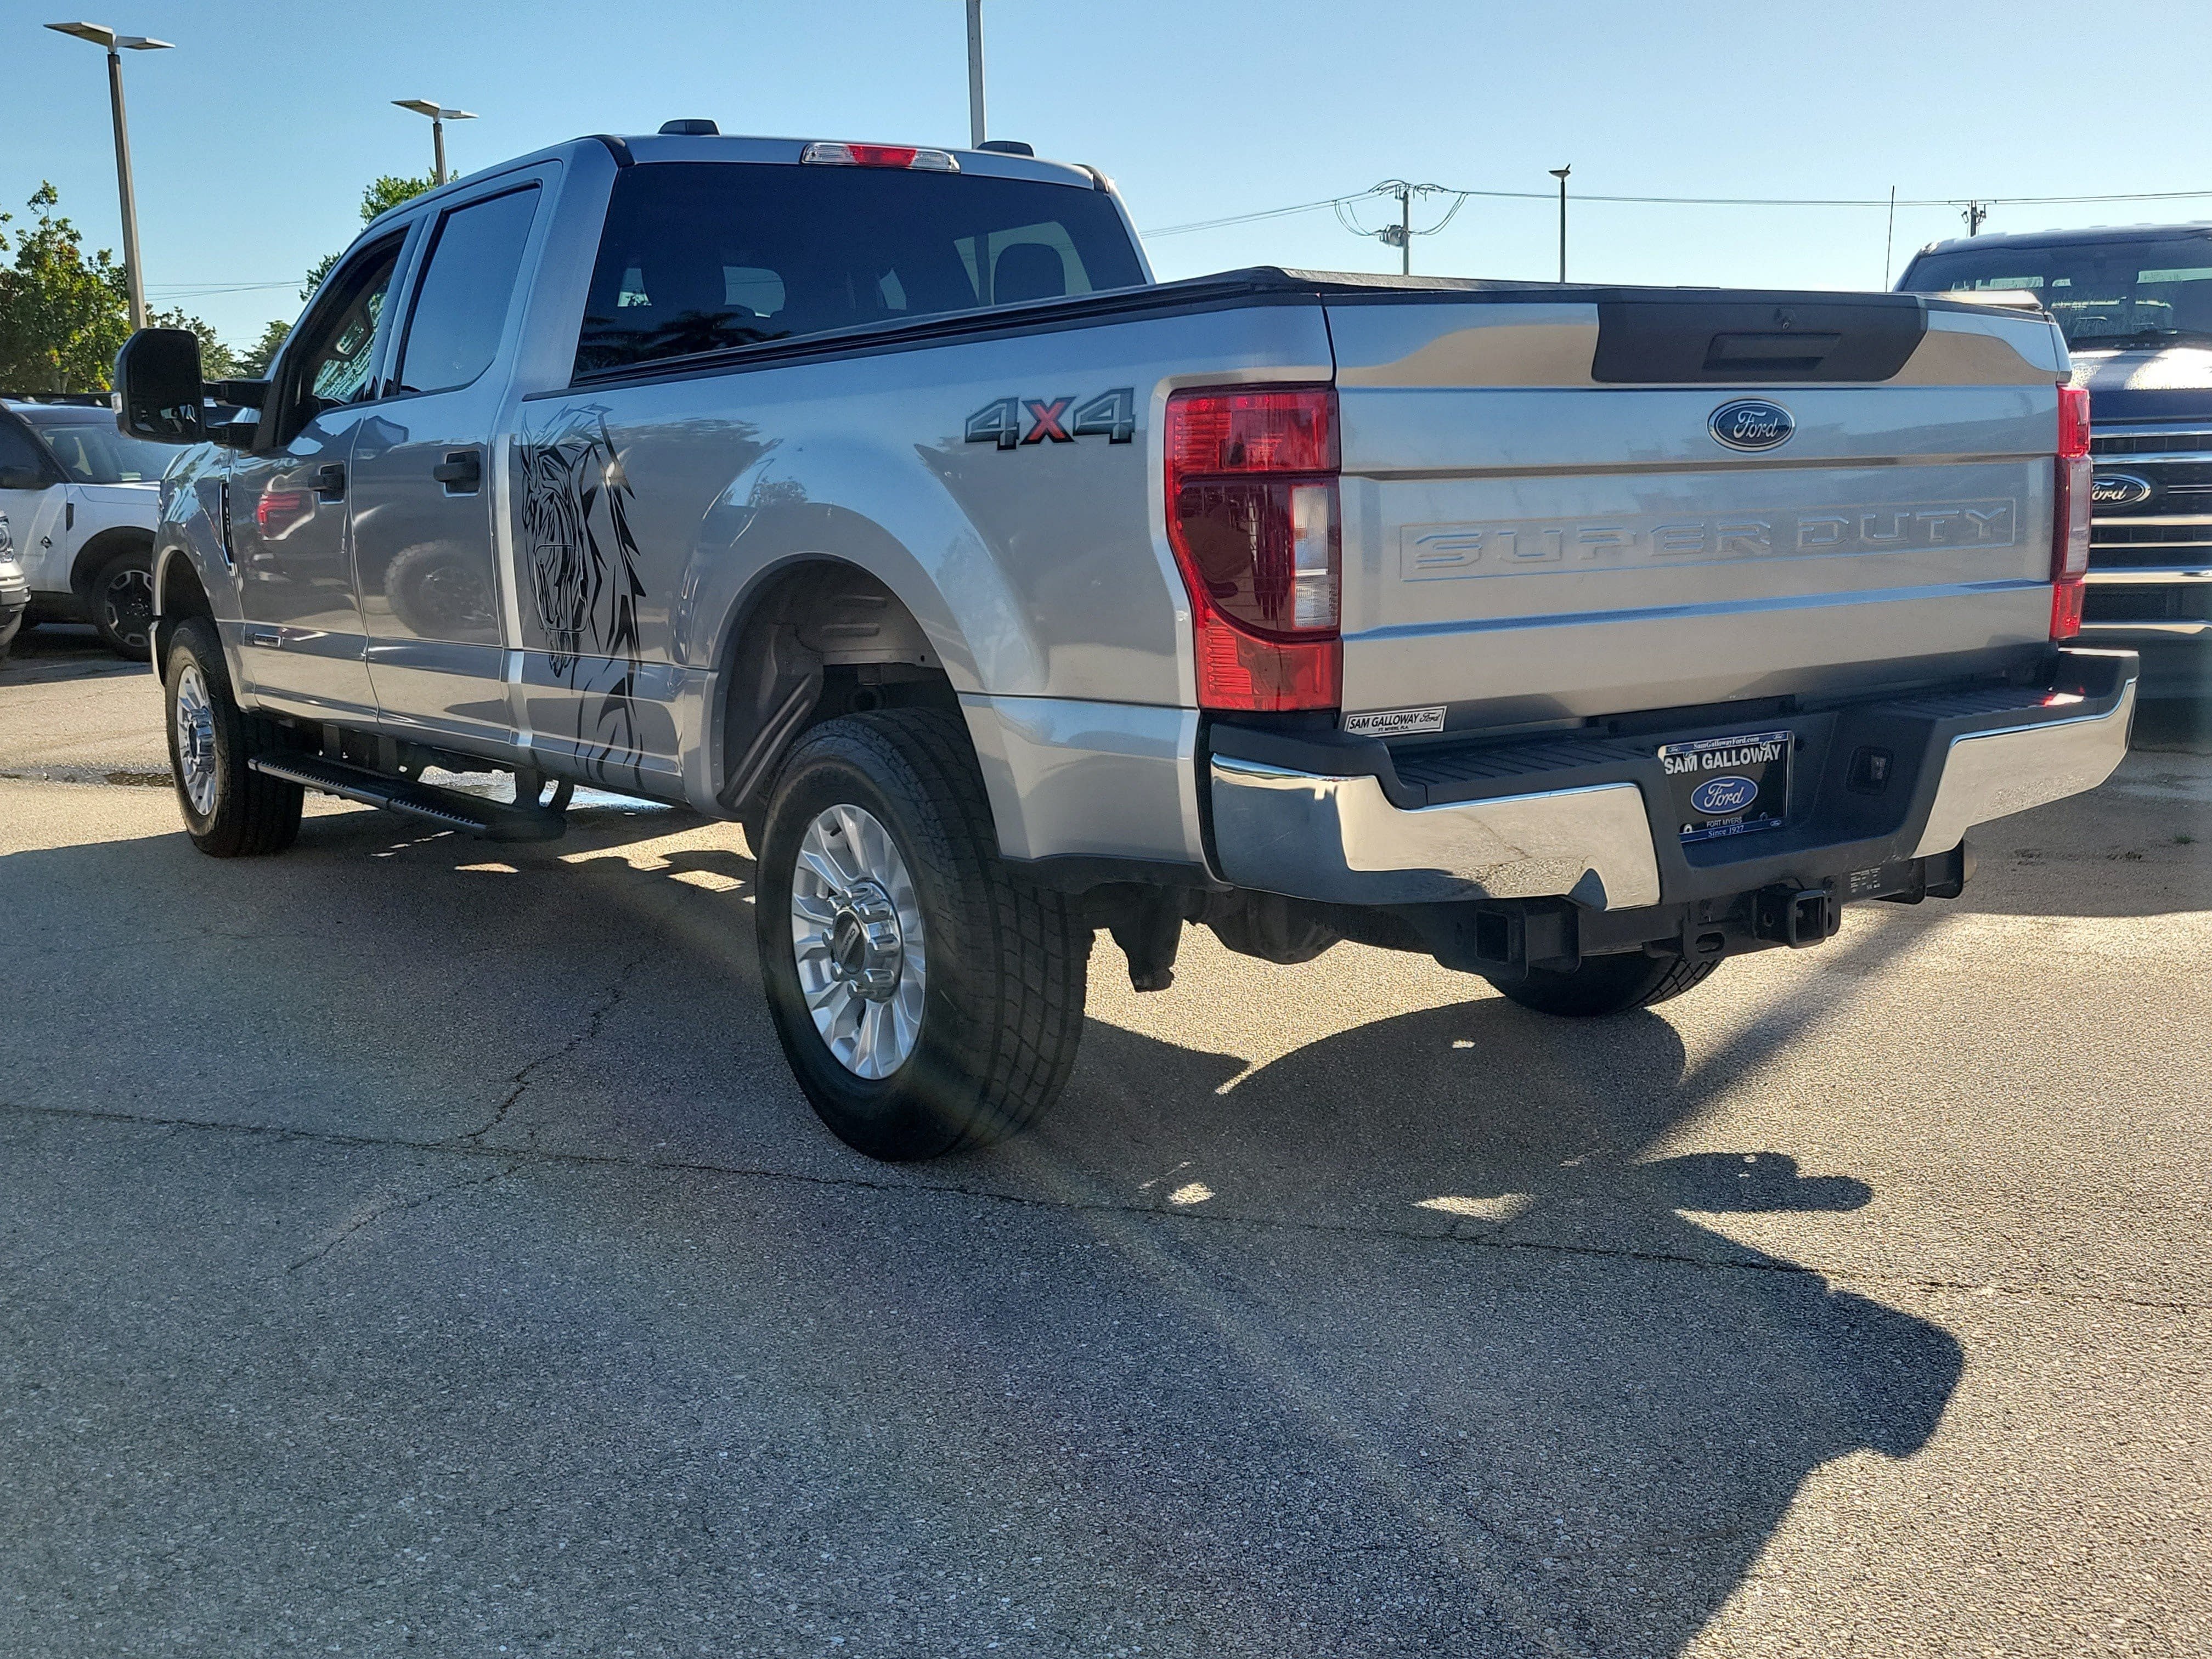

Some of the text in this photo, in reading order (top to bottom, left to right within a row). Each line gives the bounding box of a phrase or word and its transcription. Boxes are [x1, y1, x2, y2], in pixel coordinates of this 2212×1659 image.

[1733, 410, 1779, 439] Ford
[1415, 507, 2007, 569] SUPER DUTY
[1349, 713, 1441, 730] SAM GALLOWAY Ford
[1692, 736, 1759, 750] SamGallowayFord.com
[1663, 744, 1782, 775] SAM GALLOWAY
[1703, 782, 1745, 808] Ford
[1706, 816, 1743, 828] FORT MYERS
[1708, 825, 1745, 838] Since 1927
